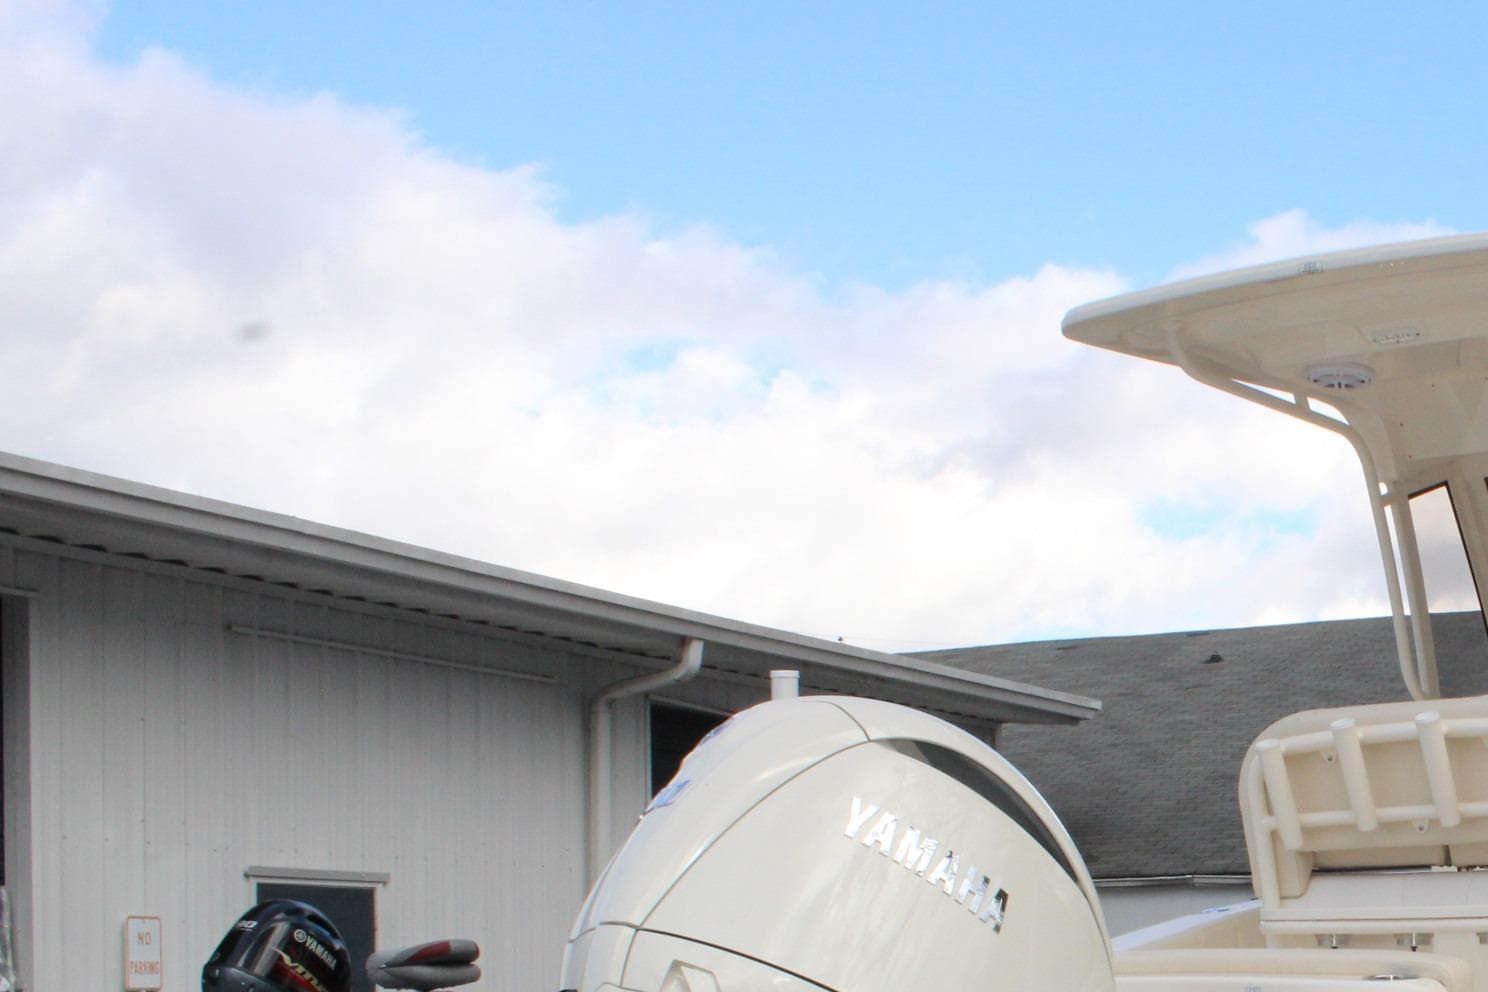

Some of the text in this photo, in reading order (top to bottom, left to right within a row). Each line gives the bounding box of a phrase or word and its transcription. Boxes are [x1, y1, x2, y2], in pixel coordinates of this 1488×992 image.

[843, 796, 1010, 934] YAMAHA
[137, 930, 152, 945] NO
[305, 935, 337, 971] YAMAHA
[129, 960, 160, 975] PARKING
